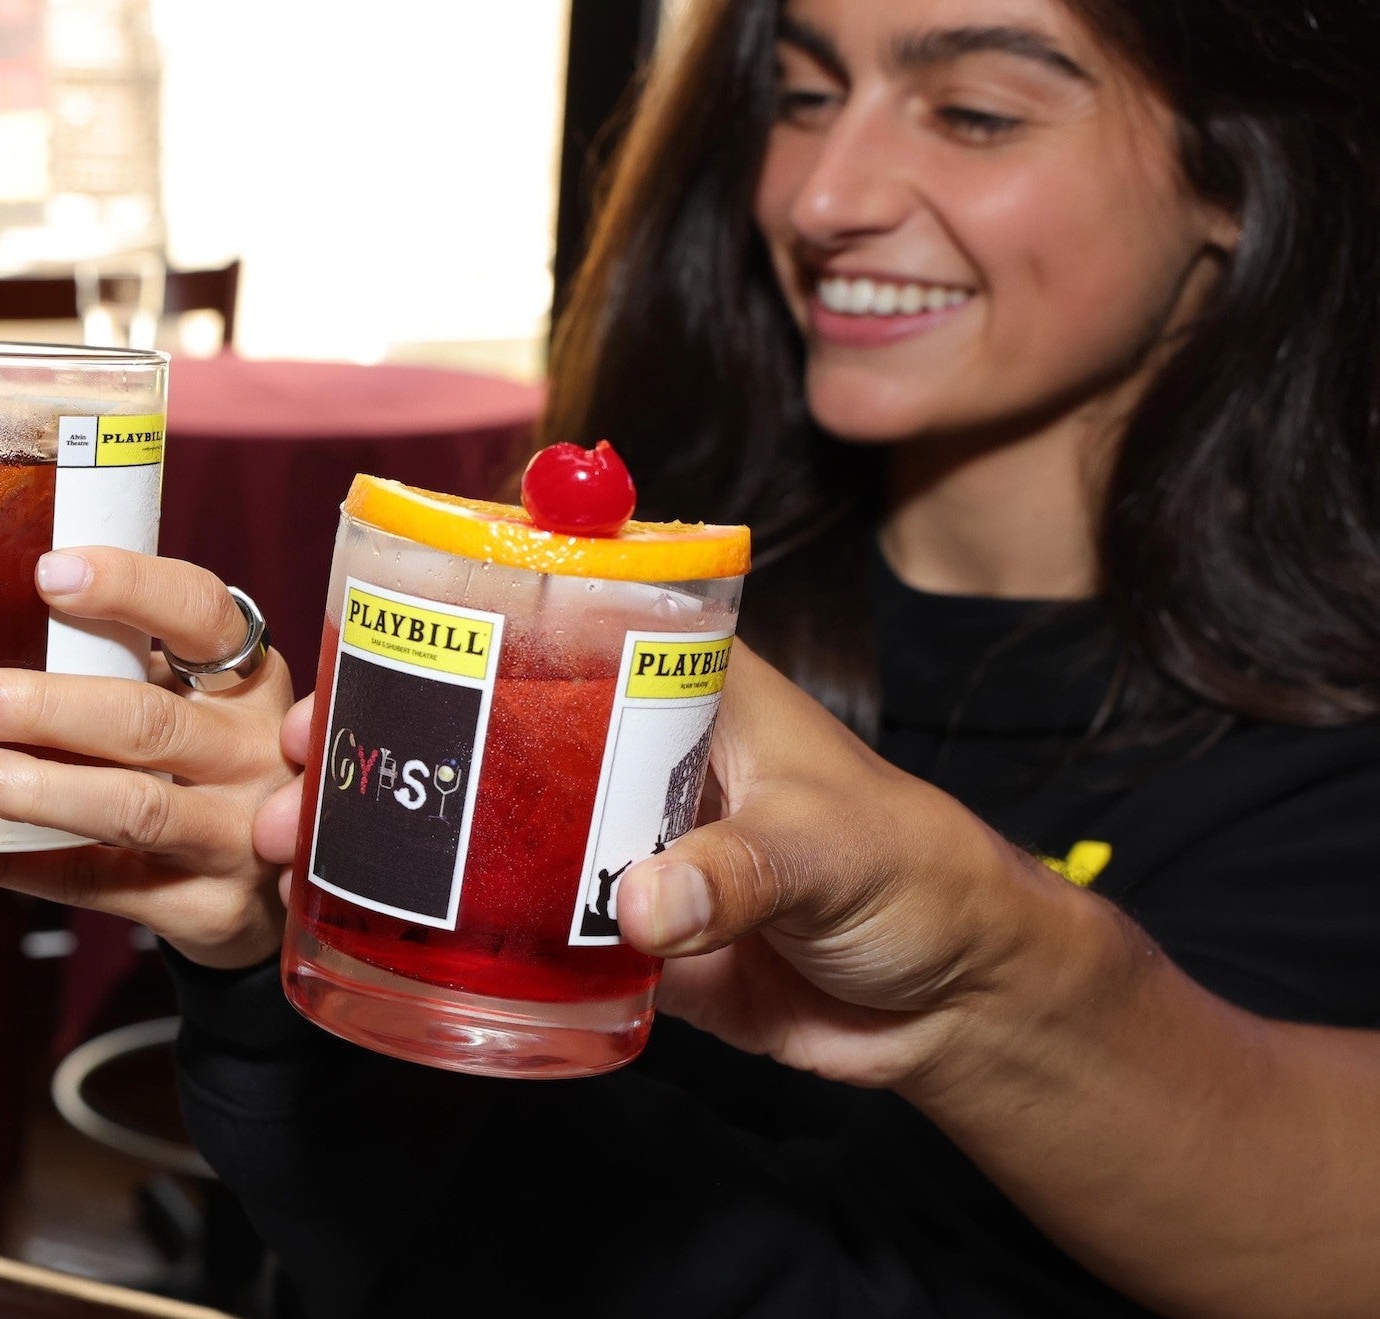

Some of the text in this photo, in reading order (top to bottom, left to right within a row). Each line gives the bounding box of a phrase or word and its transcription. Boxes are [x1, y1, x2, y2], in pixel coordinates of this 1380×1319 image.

[101, 431, 163, 444] PLAYBIL
[348, 599, 484, 656] PLAYBILL
[411, 649, 438, 661] THEATRE
